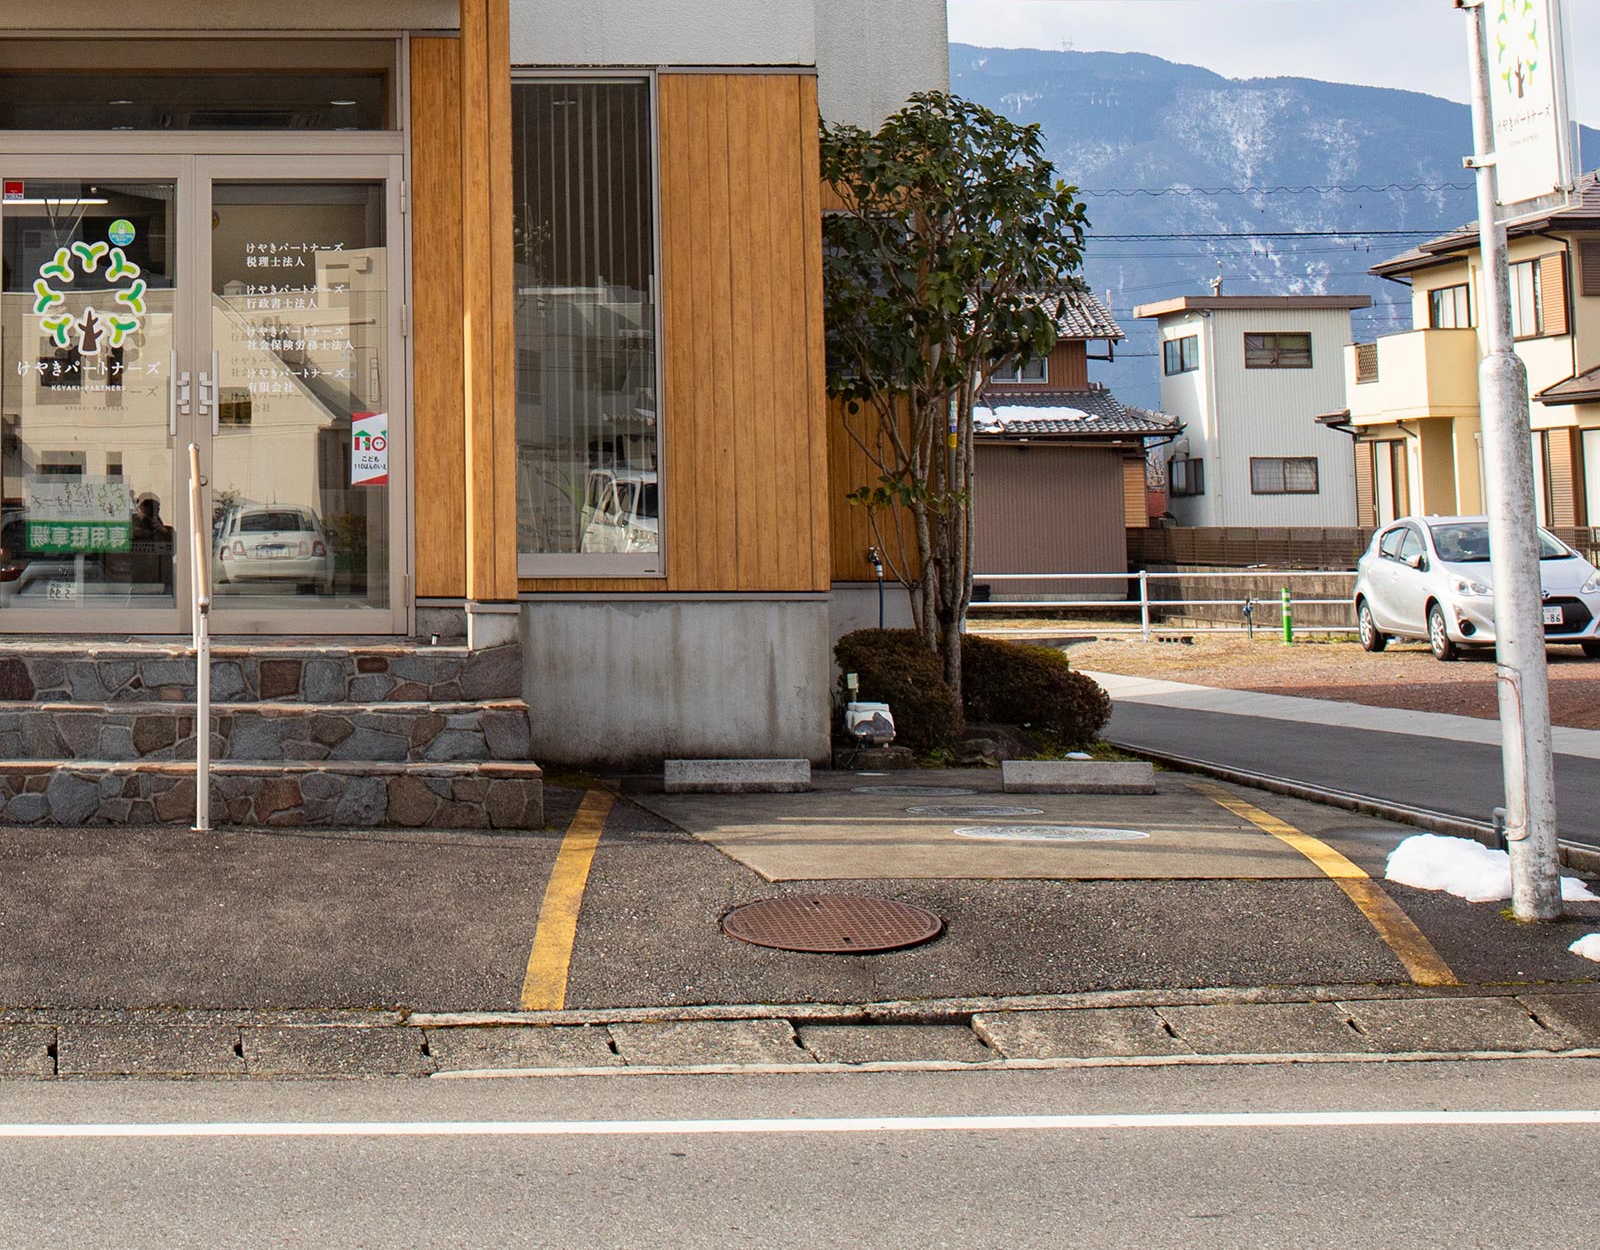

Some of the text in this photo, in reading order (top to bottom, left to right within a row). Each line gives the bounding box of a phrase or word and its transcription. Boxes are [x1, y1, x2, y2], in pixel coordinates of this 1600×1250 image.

[246, 242, 344, 253] けやきパートナーズ
[246, 256, 305, 267] 税理士法人
[246, 284, 345, 295] けやきパートナーズ
[246, 298, 318, 309] 行政書士法人
[246, 326, 345, 337] けやきパートナーズ
[247, 340, 354, 351] 社会保険労務士法人
[17, 361, 161, 376] けやきパートナーズ
[247, 368, 345, 379] けやきパートナーズ
[51, 384, 80, 392] KEYAKI
[85, 384, 126, 392] PARTNERS
[248, 382, 294, 392] 有限会社
